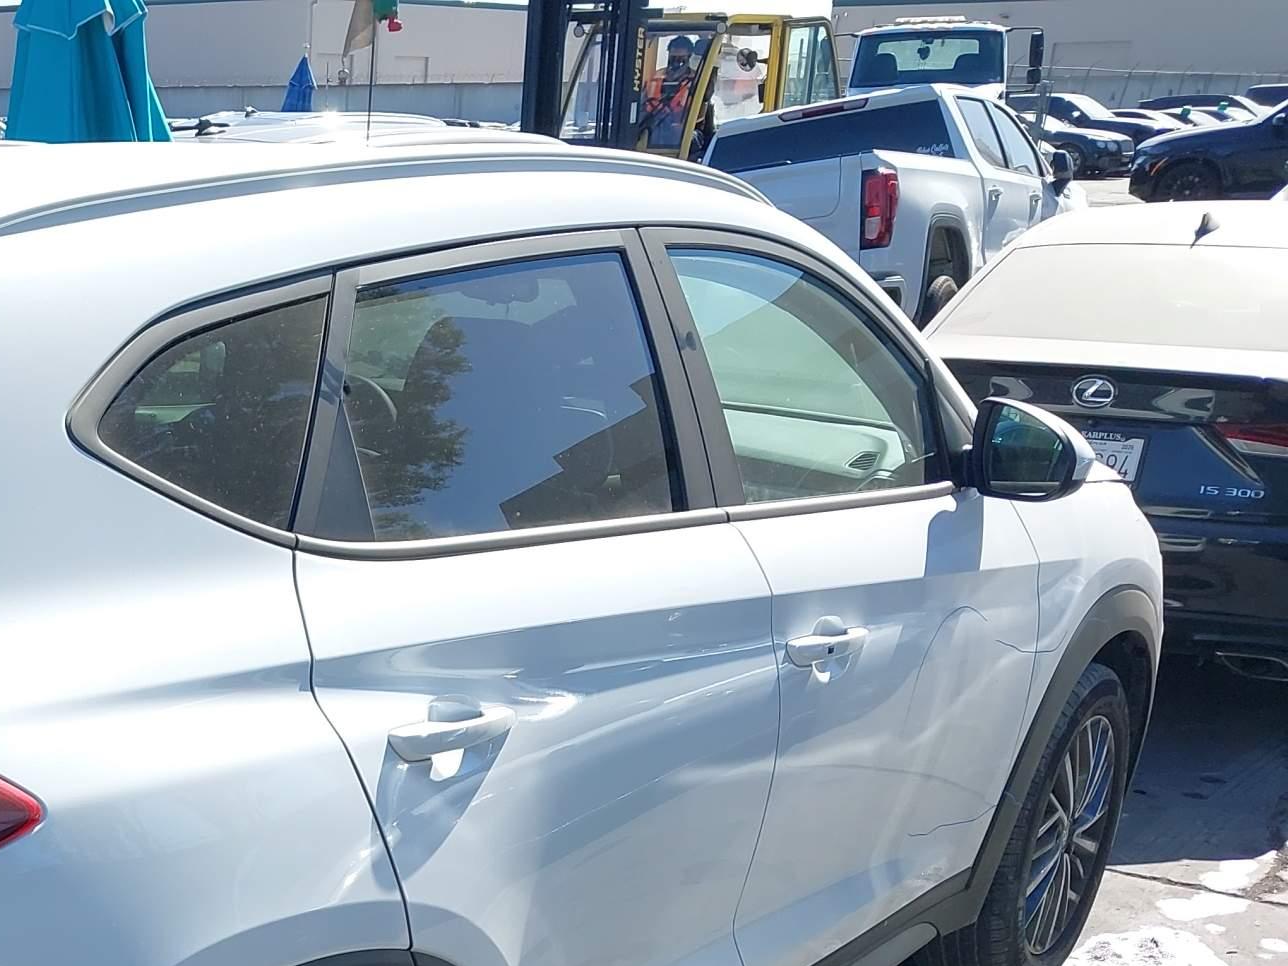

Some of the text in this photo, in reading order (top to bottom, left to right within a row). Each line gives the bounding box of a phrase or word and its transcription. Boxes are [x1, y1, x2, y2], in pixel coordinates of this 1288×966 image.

[633, 27, 645, 91] HYSTER
[1200, 485, 1265, 499] IS 300
